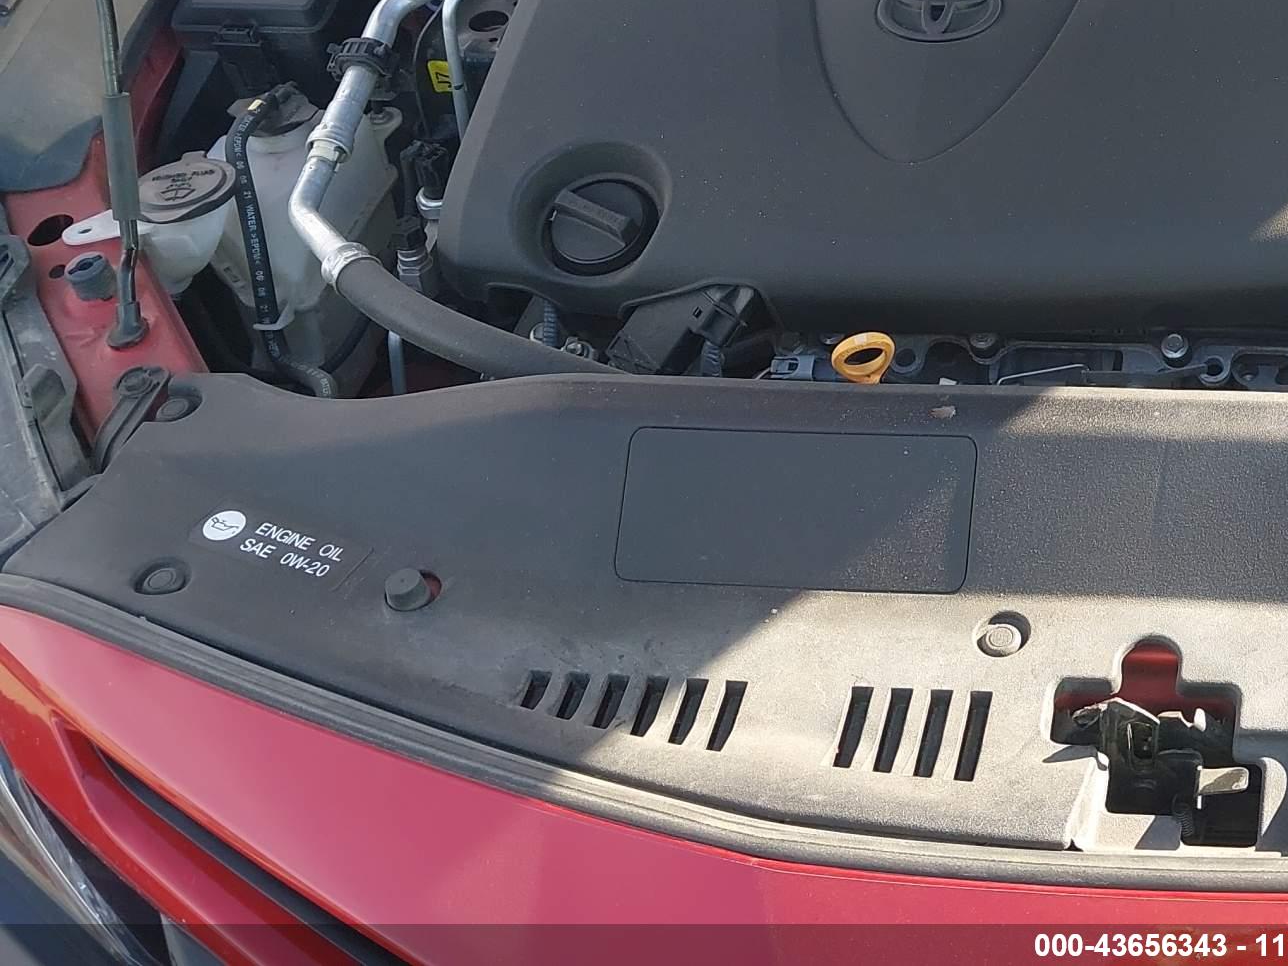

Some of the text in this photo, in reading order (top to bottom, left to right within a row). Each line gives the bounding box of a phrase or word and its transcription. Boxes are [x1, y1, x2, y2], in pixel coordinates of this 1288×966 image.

[244, 203, 258, 233] WATER
[240, 538, 331, 577] SAE 0W-20
[255, 522, 344, 562] ENGINE OIL
